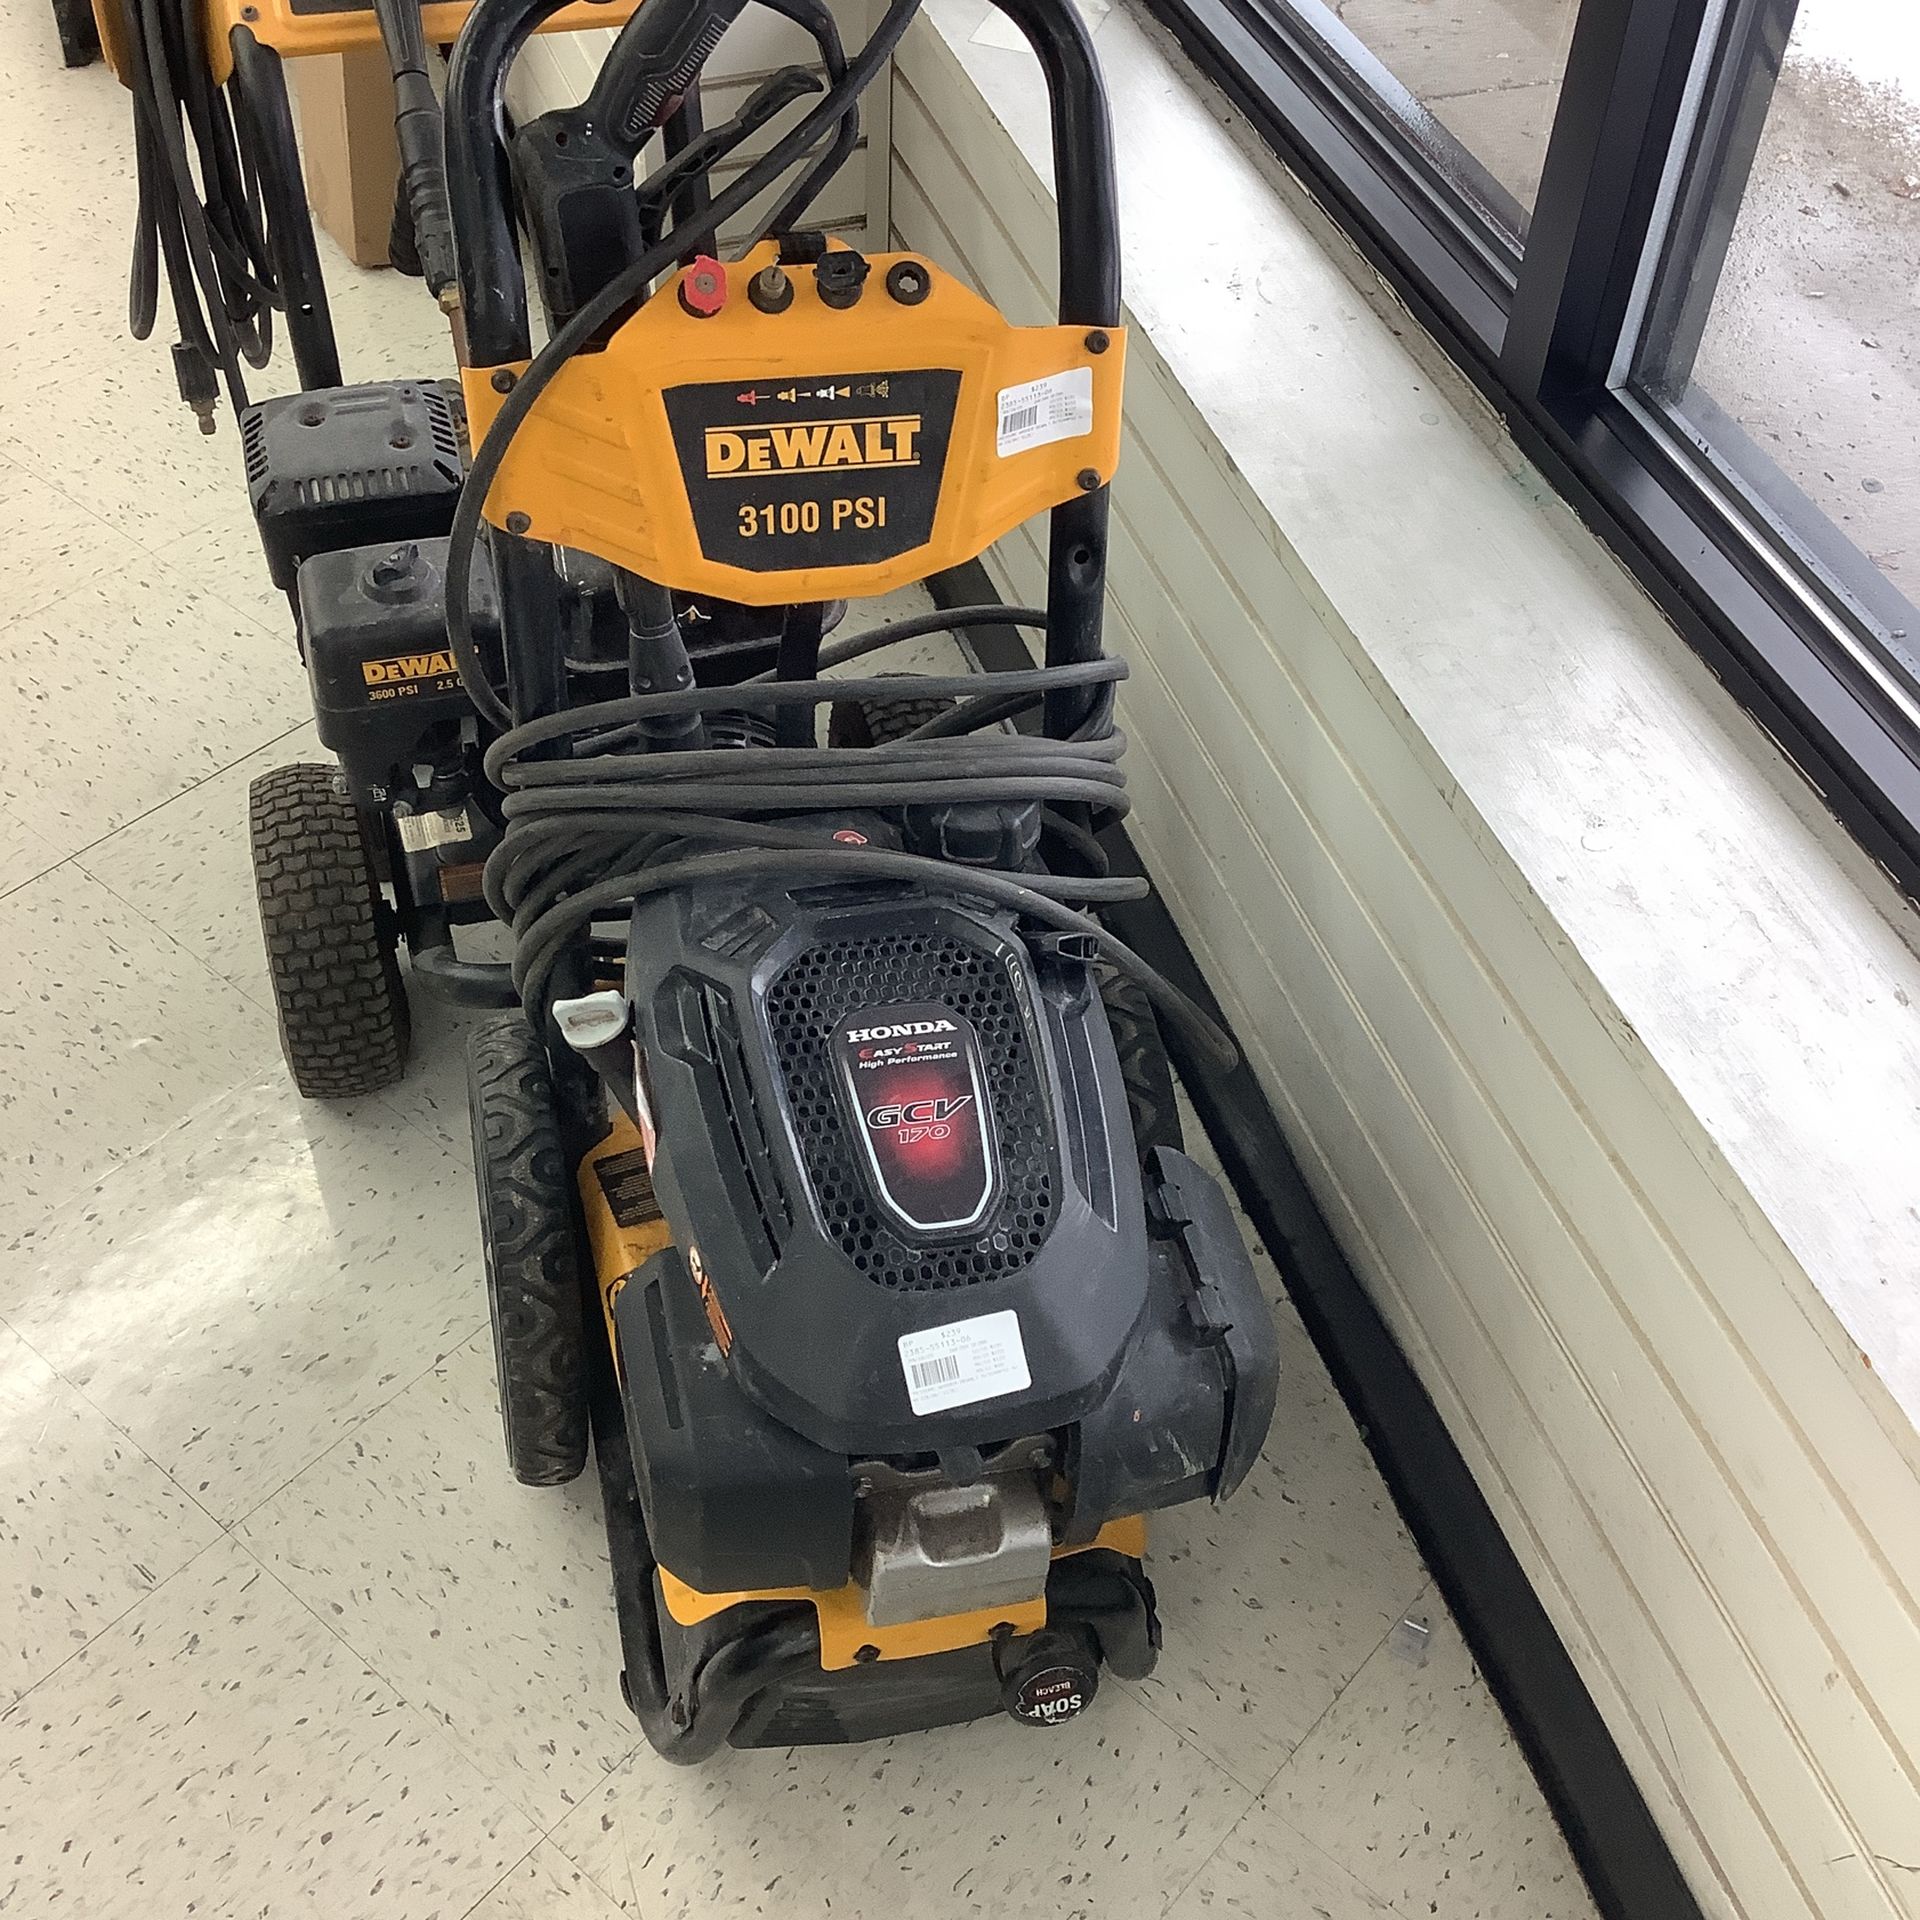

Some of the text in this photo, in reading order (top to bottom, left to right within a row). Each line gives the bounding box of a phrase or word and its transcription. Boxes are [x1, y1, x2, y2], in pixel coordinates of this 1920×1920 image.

[738, 496, 886, 537] 3100 PSI
[368, 688, 396, 701] 3600
[398, 685, 418, 697] PSI
[436, 679, 454, 690] 2.5
[846, 1019, 958, 1043] HONDA
[858, 1051, 958, 1069] High Performance
[867, 1095, 974, 1129] GCV
[898, 1124, 951, 1144] 170
[940, 1328, 961, 1338] $239
[1035, 1681, 1071, 1697] BLEACH
[1029, 1694, 1082, 1717] SOAP
